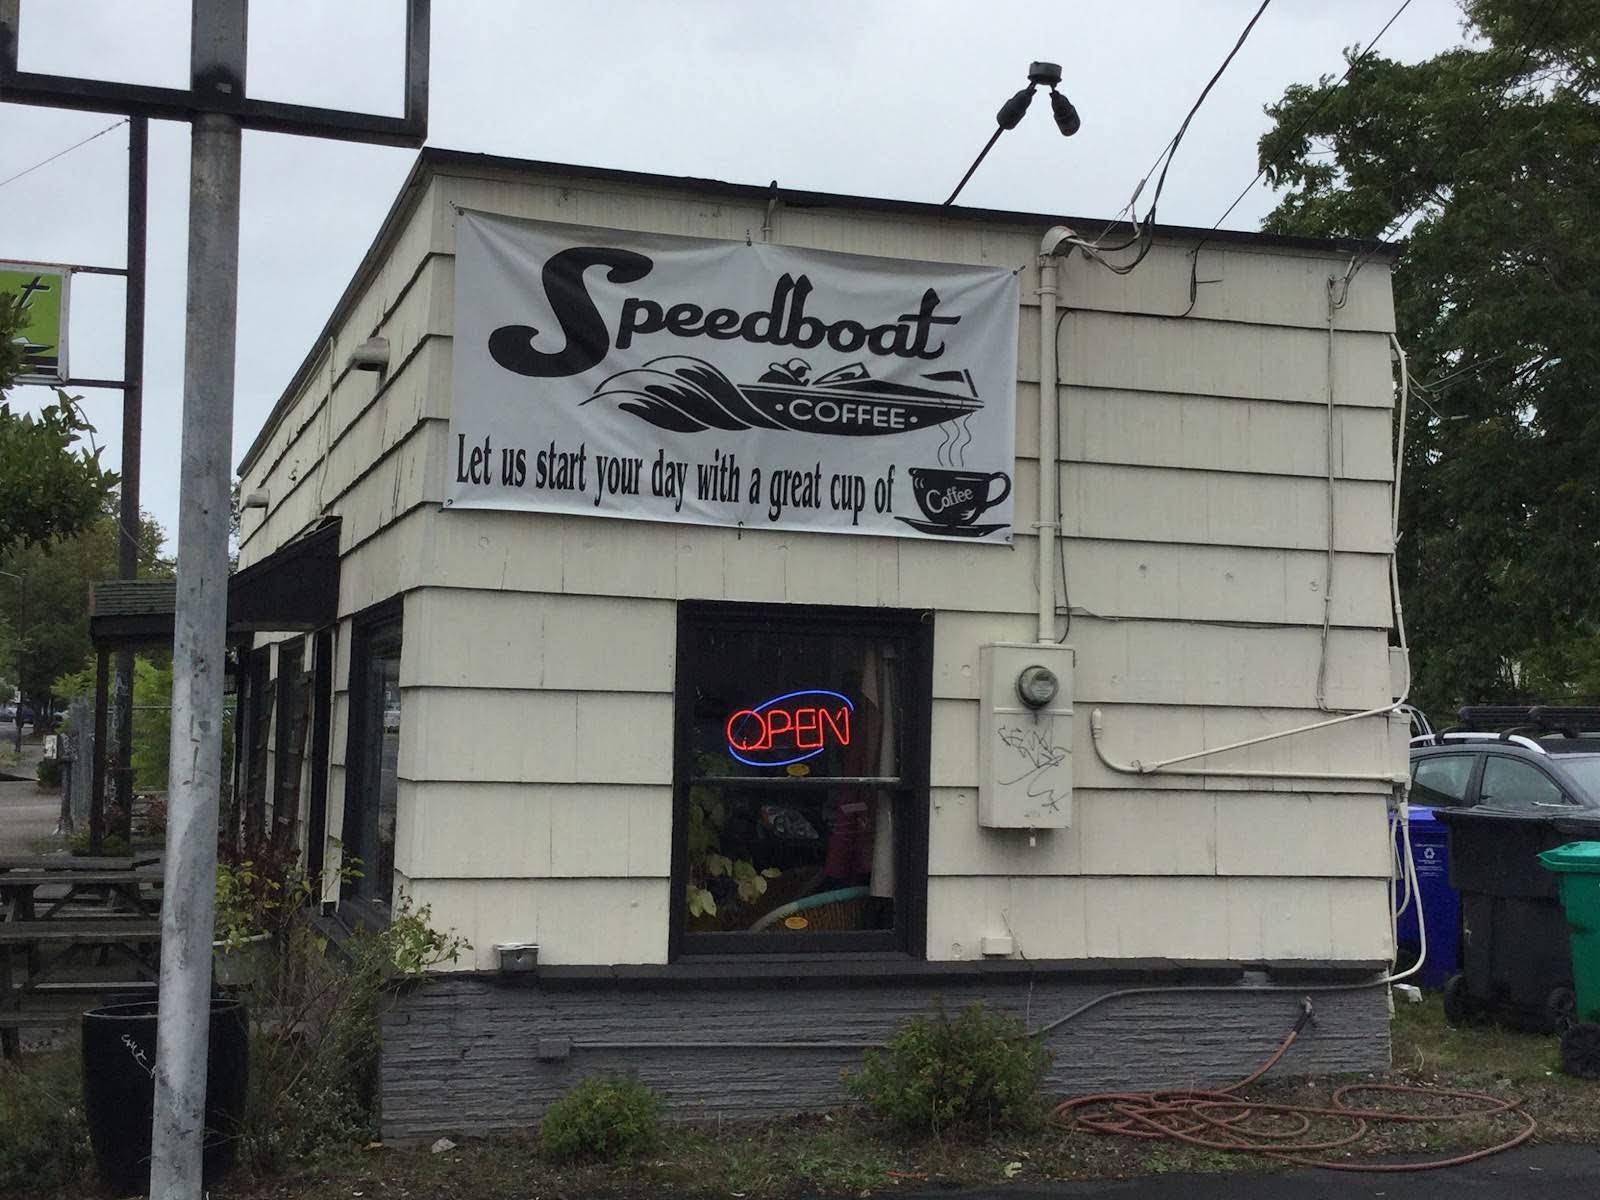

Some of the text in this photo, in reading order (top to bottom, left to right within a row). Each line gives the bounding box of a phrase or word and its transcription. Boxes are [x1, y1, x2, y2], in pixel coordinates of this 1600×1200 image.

[488, 246, 961, 377] Speedboat
[788, 399, 906, 428] COFFEE
[457, 433, 896, 526] Let us start your day with a great cup of
[926, 486, 974, 513] Coffee
[727, 706, 850, 750] OPEN
